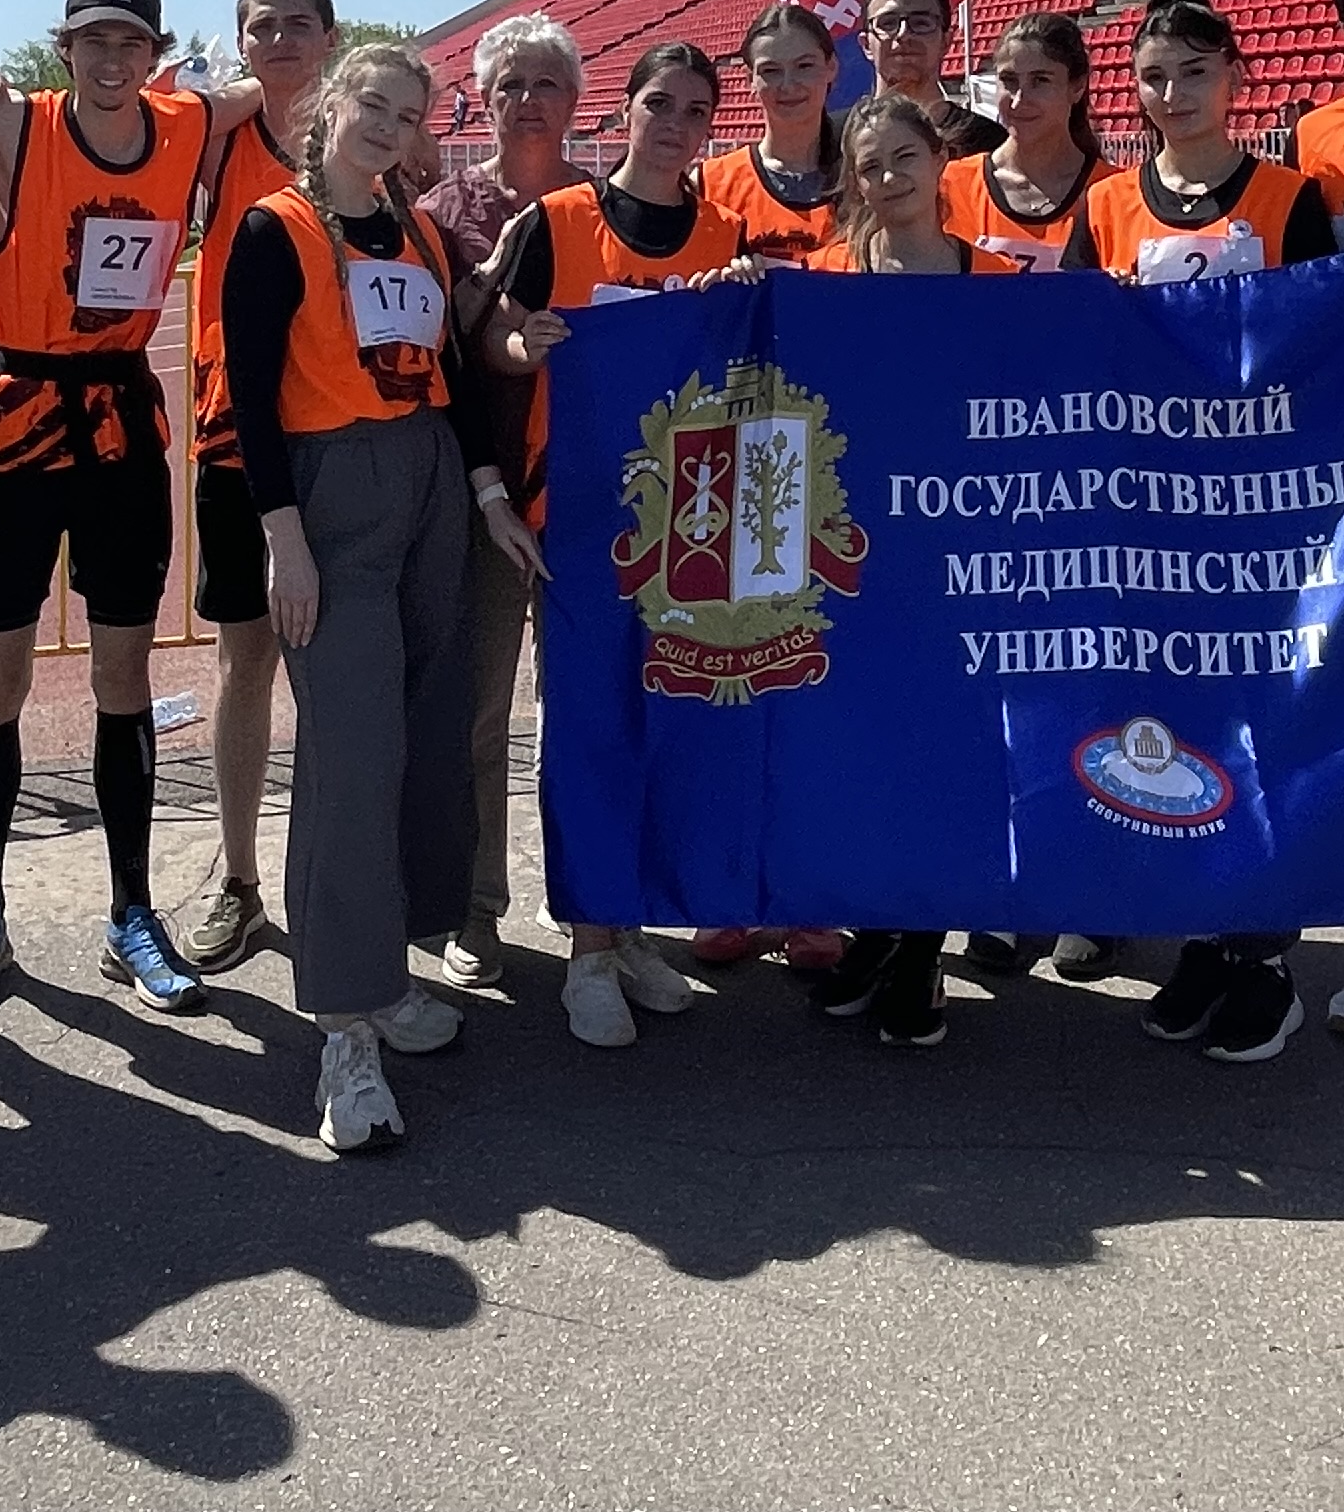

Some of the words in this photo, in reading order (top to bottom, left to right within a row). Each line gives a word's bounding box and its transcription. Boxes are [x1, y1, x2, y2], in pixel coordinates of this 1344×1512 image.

[100, 234, 154, 271] 27
[369, 276, 407, 311] 17
[419, 294, 431, 314] 2
[966, 384, 1295, 439] ИВАНОВСКИЙ
[945, 534, 1338, 602] МЕДИЦИНСКИЙ
[703, 652, 734, 671] est
[741, 630, 815, 668] veritas
[960, 623, 1328, 676] УНИВЕРСИТЕТ
[1189, 819, 1226, 838] КЛУБ
